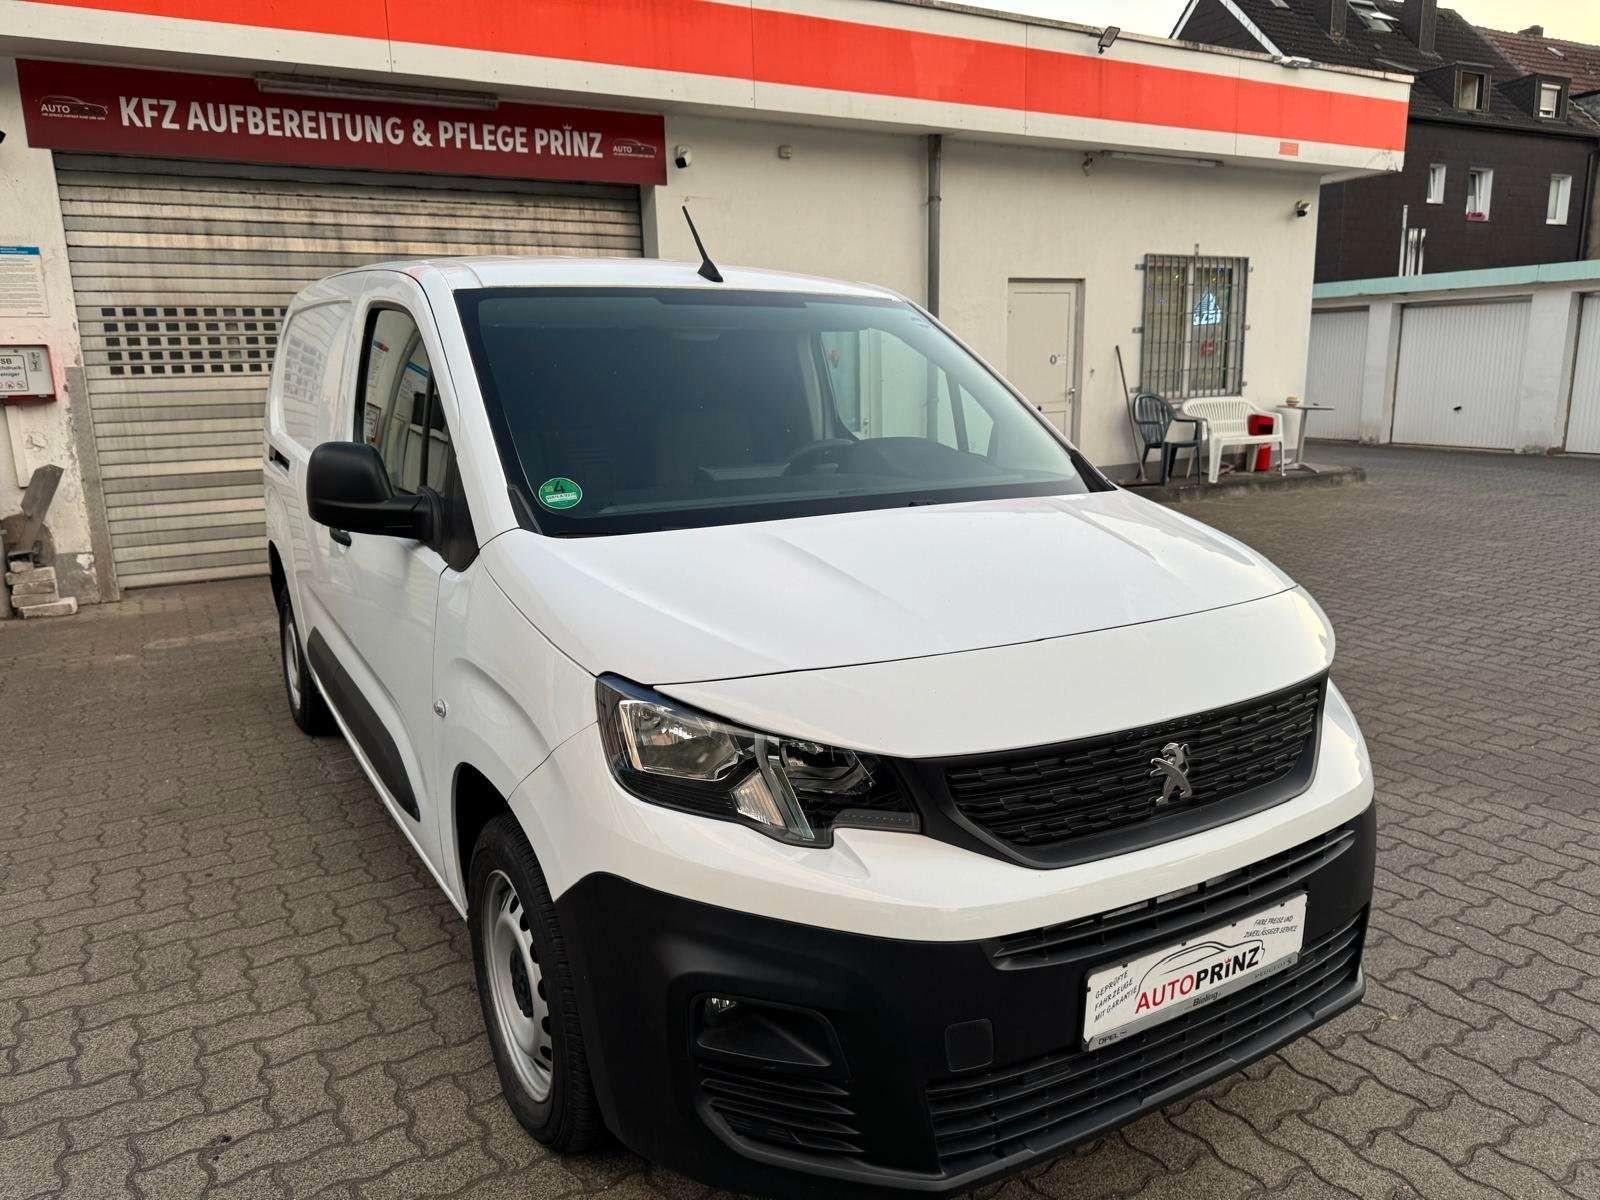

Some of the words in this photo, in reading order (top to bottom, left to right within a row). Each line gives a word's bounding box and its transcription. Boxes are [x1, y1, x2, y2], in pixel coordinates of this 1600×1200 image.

[41, 104, 71, 113] AUTO
[118, 96, 180, 130] KFZ
[187, 101, 405, 145] AUFBEREITUNG
[412, 118, 433, 147] &
[438, 120, 530, 154] PFLEGE
[535, 122, 604, 159] PRINZ
[613, 145, 633, 153] AUTO
[554, 481, 566, 493] 4
[1094, 1010, 1106, 1023] MIT
[1107, 984, 1138, 1014] GARANTIE
[1095, 977, 1134, 1011] FAHRZEUGE
